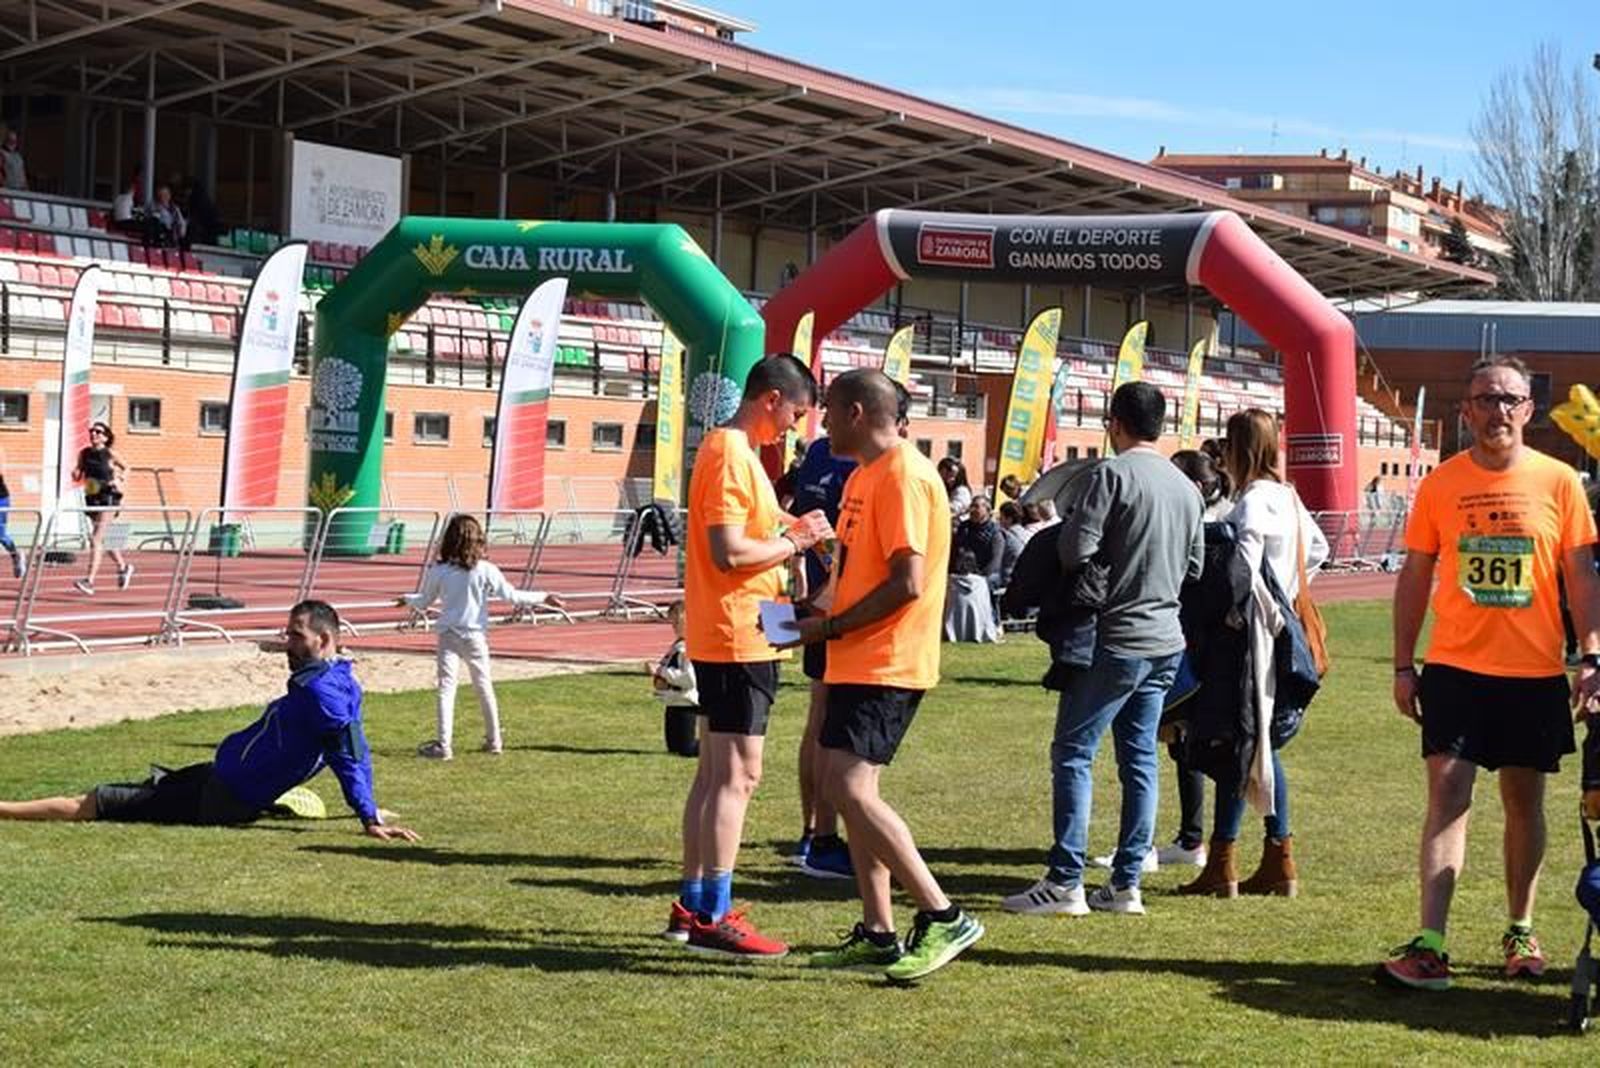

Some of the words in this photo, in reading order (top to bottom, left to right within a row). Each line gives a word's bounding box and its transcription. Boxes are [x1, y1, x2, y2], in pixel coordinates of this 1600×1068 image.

[1009, 227, 1048, 245] CON
[1053, 228, 1073, 245] EL
[1077, 228, 1162, 246] DEPORTE
[464, 244, 530, 270] CAJA
[538, 247, 633, 273] RURAL
[935, 245, 989, 259] ZAMORA
[1008, 251, 1096, 270] GANAMOS
[1100, 252, 1163, 270] TODOS
[1467, 556, 1522, 586] 361
